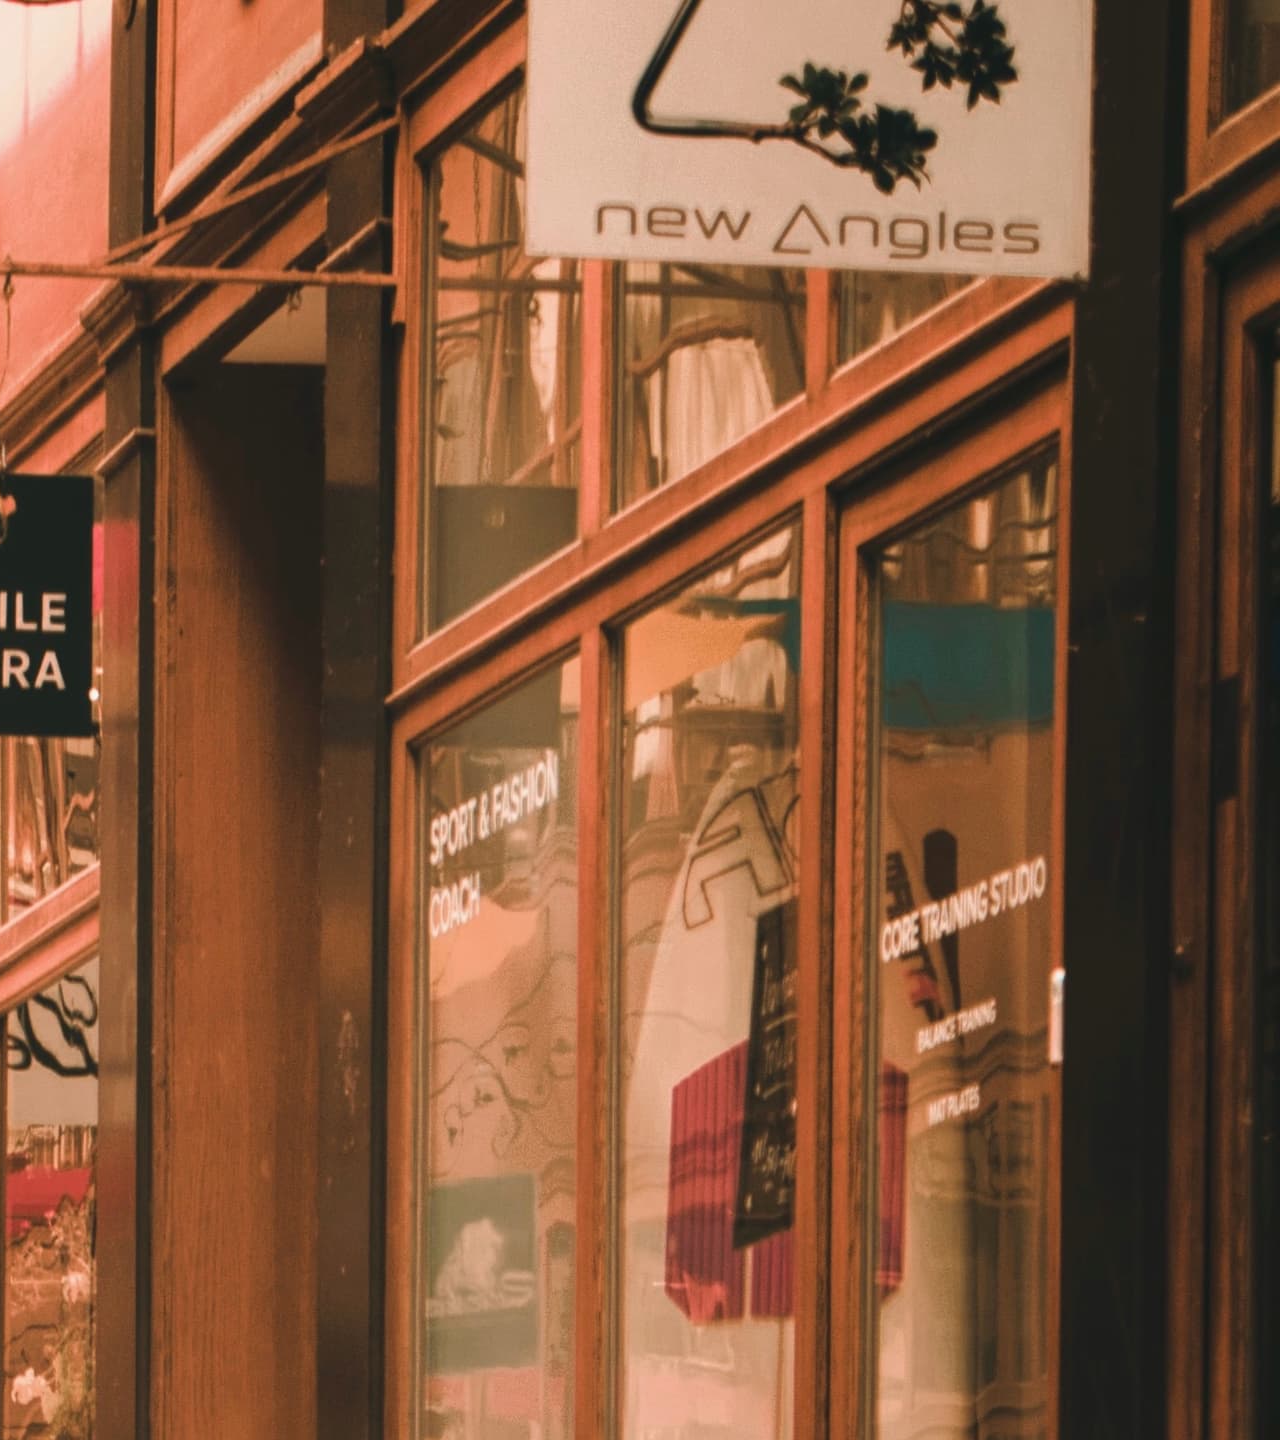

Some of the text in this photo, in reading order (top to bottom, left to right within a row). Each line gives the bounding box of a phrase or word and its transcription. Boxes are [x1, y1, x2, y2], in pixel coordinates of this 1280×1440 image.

[596, 202, 1040, 259] new Angles
[429, 749, 559, 866] SPORT & FASHION
[429, 871, 481, 938] COACH
[882, 912, 921, 963] CORE
[920, 884, 989, 945] TRAINING
[991, 855, 1048, 917] STUDIO
[917, 998, 997, 1054] BALANCE TRAINING
[928, 1084, 981, 1127] MAT PILATES
